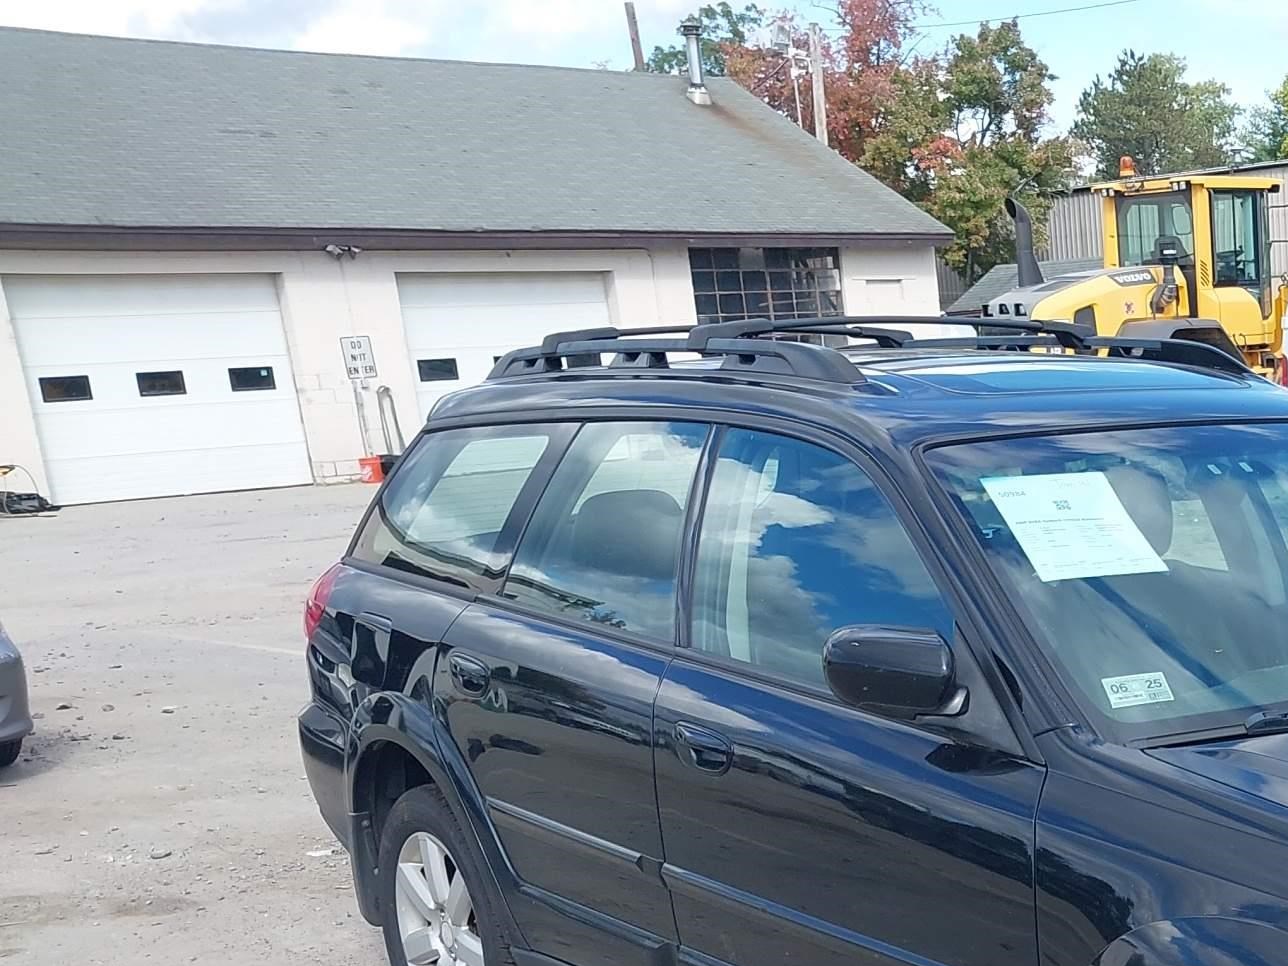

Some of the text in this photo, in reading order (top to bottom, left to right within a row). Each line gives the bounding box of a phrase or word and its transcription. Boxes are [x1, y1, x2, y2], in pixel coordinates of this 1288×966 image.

[1115, 273, 1152, 283] VOLVO
[350, 341, 362, 349] DO
[1110, 679, 1162, 694] 06 25
